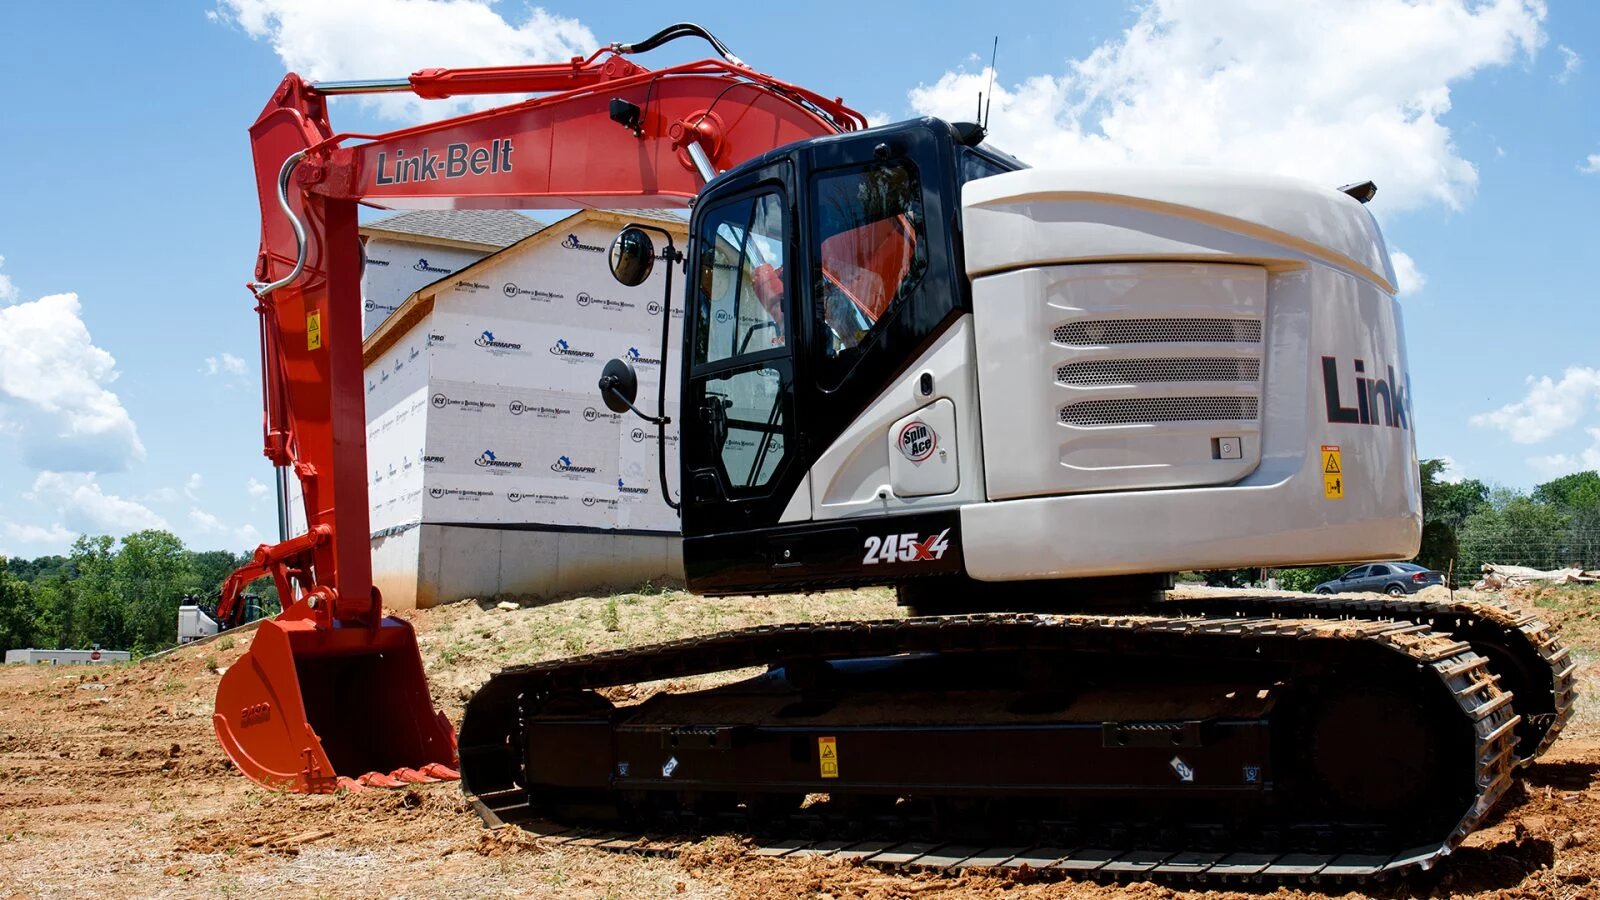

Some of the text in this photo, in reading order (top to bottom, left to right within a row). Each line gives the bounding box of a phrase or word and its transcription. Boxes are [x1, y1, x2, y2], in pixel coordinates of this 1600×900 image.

[376, 138, 514, 186] Link-Belt
[486, 341, 521, 350] PERMAPRO
[561, 349, 594, 357] PERMAPRO
[632, 357, 661, 365] PERMAPR
[1321, 355, 1413, 430] Link
[904, 426, 927, 445] Spin
[912, 439, 932, 456] Ace
[486, 460, 522, 468] PERMAPRO
[561, 465, 596, 473] PERMAPRO
